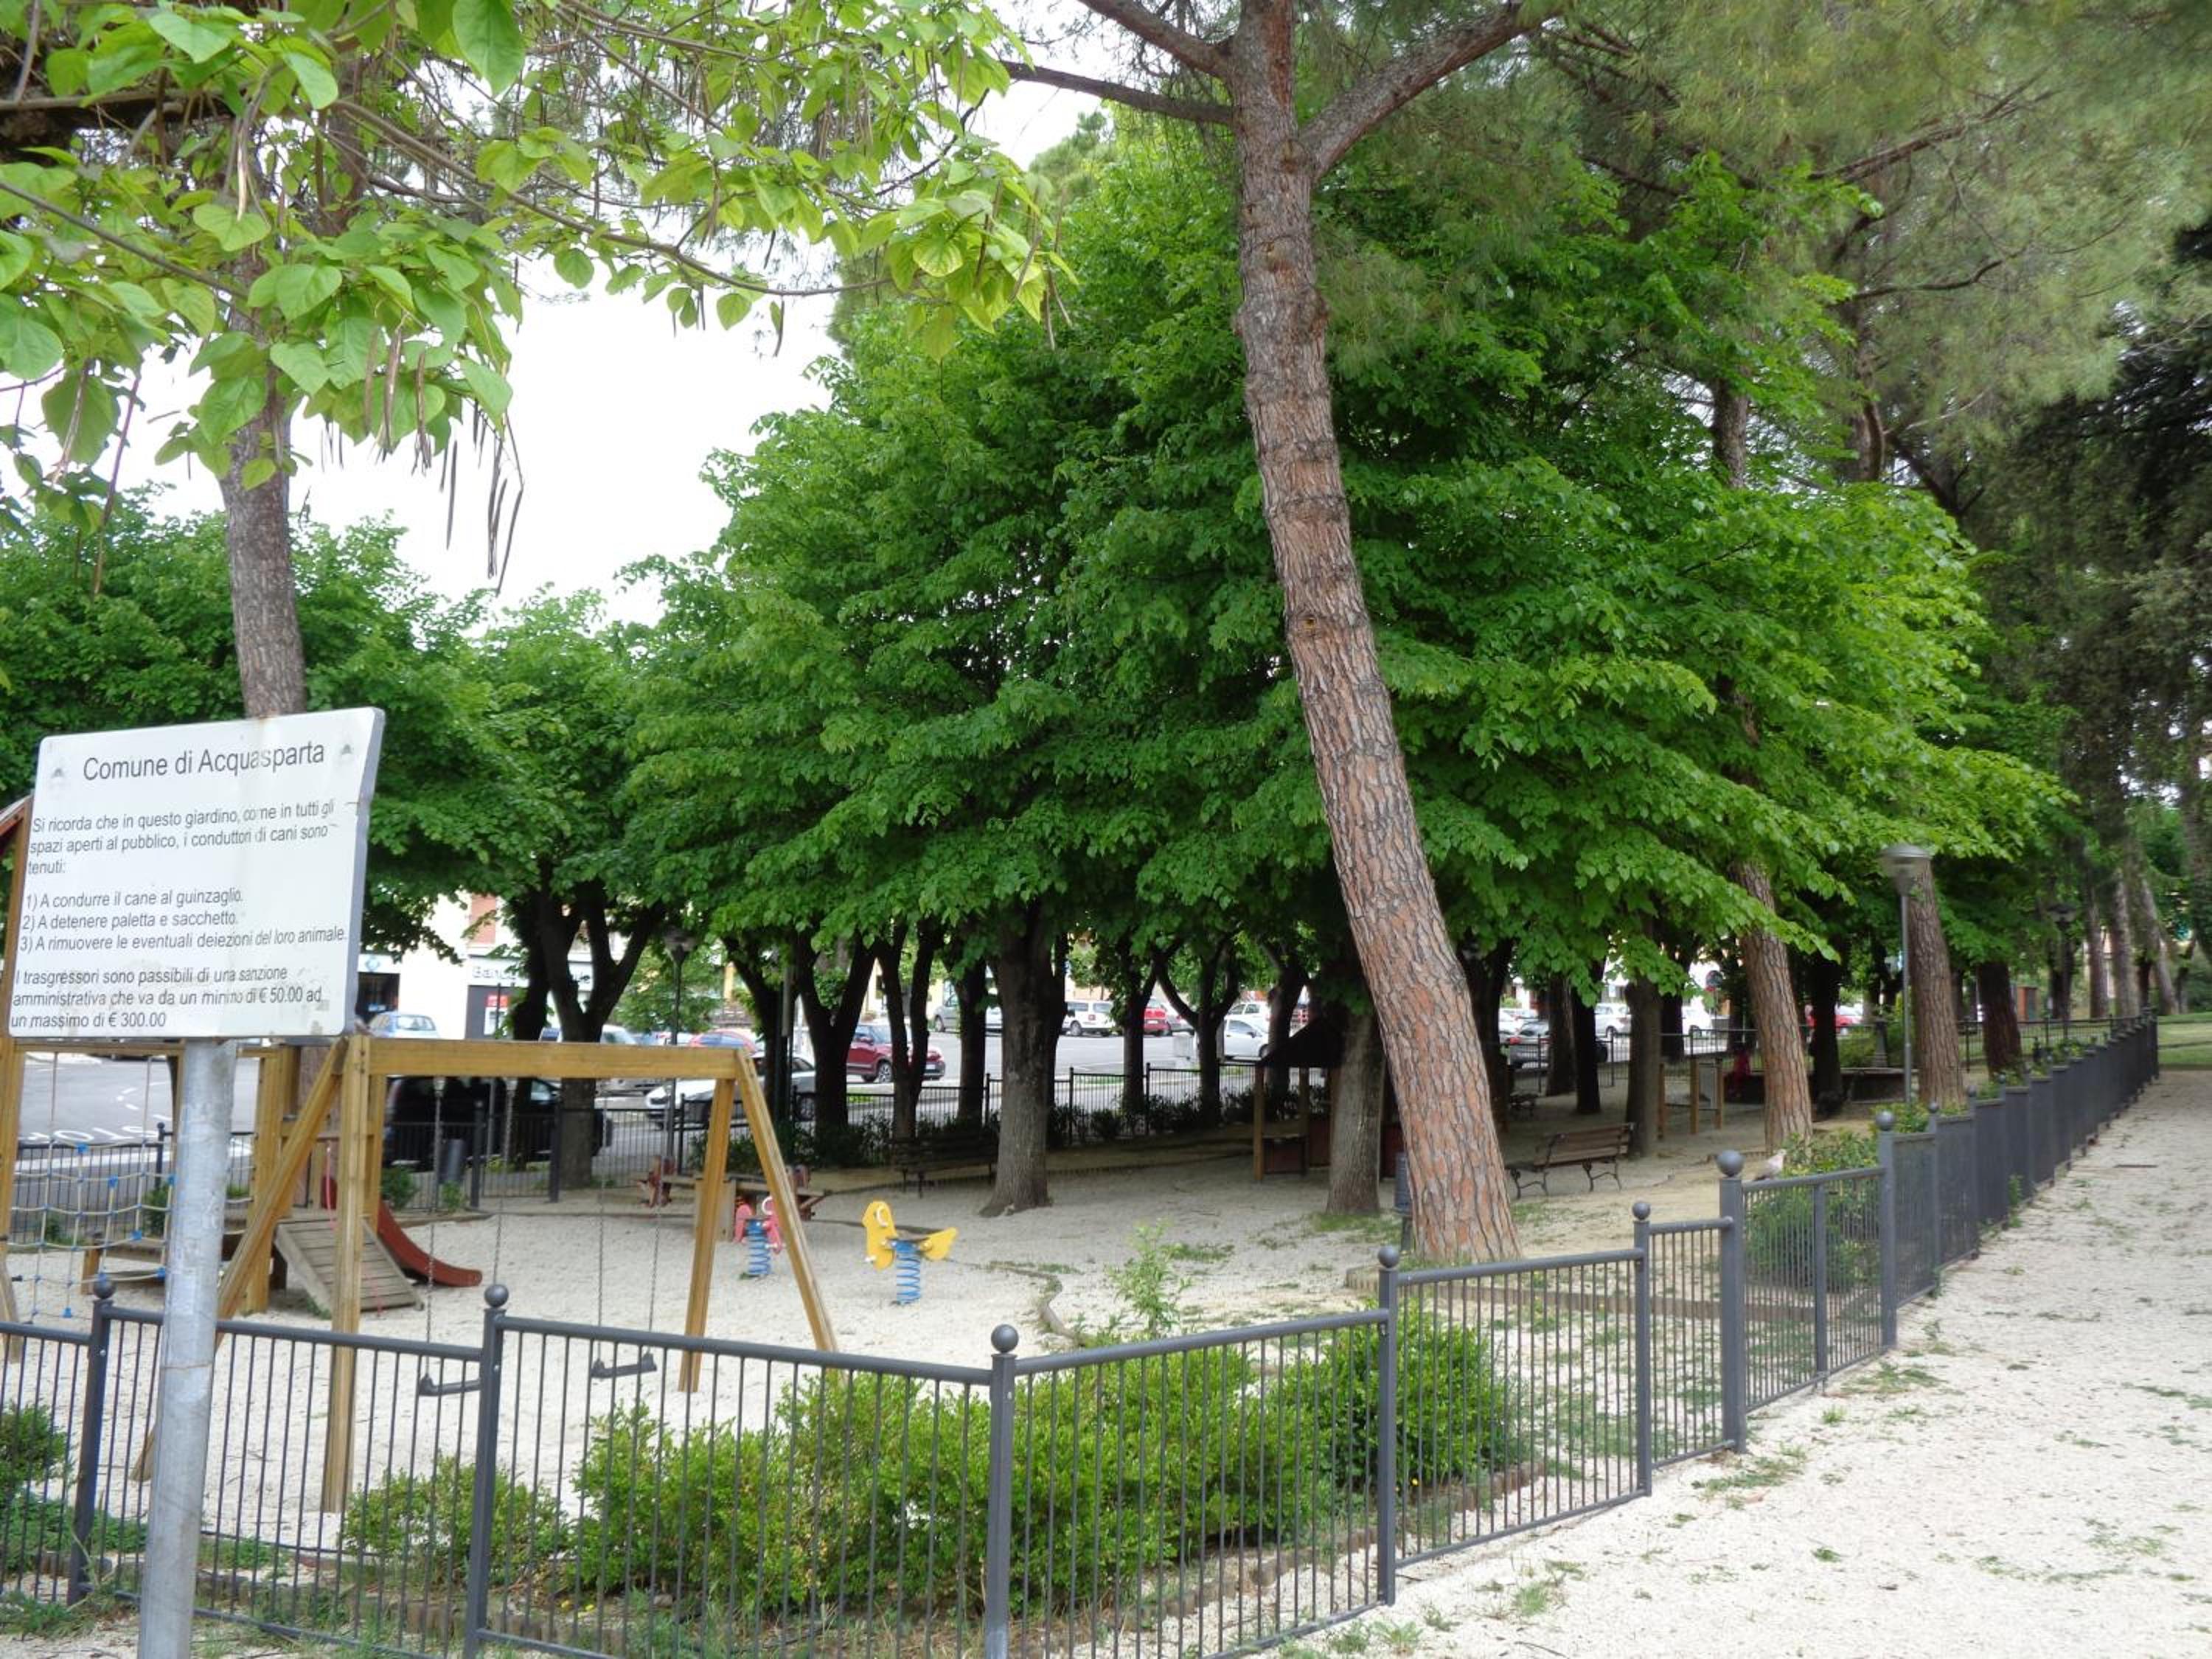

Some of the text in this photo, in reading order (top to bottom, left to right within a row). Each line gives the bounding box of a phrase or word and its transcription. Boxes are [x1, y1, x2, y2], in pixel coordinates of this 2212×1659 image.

[83, 740, 324, 781] Comune di Acquasparta
[32, 817, 44, 832] Si
[48, 816, 92, 832] ricorda
[95, 815, 119, 830] che
[123, 813, 133, 828] in
[138, 812, 181, 831] questo
[185, 808, 242, 829] giardino,
[281, 802, 291, 818] in
[296, 800, 319, 818] tutti
[29, 838, 63, 856] spazi
[66, 835, 102, 855] aperti
[106, 836, 118, 850] al
[121, 833, 179, 854] pubblico,
[184, 832, 187, 846] i
[255, 827, 266, 842] di
[270, 826, 297, 841] cani
[300, 824, 328, 840] sono
[27, 859, 66, 875] tenuti:
[27, 893, 37, 911] 1)
[40, 893, 49, 908] A
[52, 892, 110, 908] condurre
[114, 891, 121, 905] il
[125, 892, 157, 906] cane
[160, 889, 173, 905] al
[22, 915, 35, 932] 2)
[38, 914, 47, 930] A
[50, 914, 108, 929] detenere
[111, 913, 156, 931] paletta
[159, 915, 168, 926] e
[20, 936, 33, 954] 3)
[35, 936, 45, 950] A
[48, 936, 112, 950] rimuovere
[116, 934, 128, 950] le
[131, 933, 192, 949] eventuali
[197, 931, 253, 948] deiezioni
[274, 928, 295, 945] loro
[24, 968, 100, 988] trasgressori
[102, 970, 134, 984] sono
[138, 967, 192, 987] passibili
[196, 967, 210, 983] di
[213, 969, 235, 983] una
[238, 967, 288, 982] sanzione
[13, 990, 106, 1006] amministrativa
[110, 991, 133, 1006] che
[138, 993, 154, 1005] va
[158, 989, 175, 1005] da
[180, 993, 197, 1005] un
[246, 988, 257, 1004] di
[270, 986, 303, 1004] 50.00
[306, 987, 322, 1003] ad
[11, 1012, 167, 1028] un massimo di € 300.00
